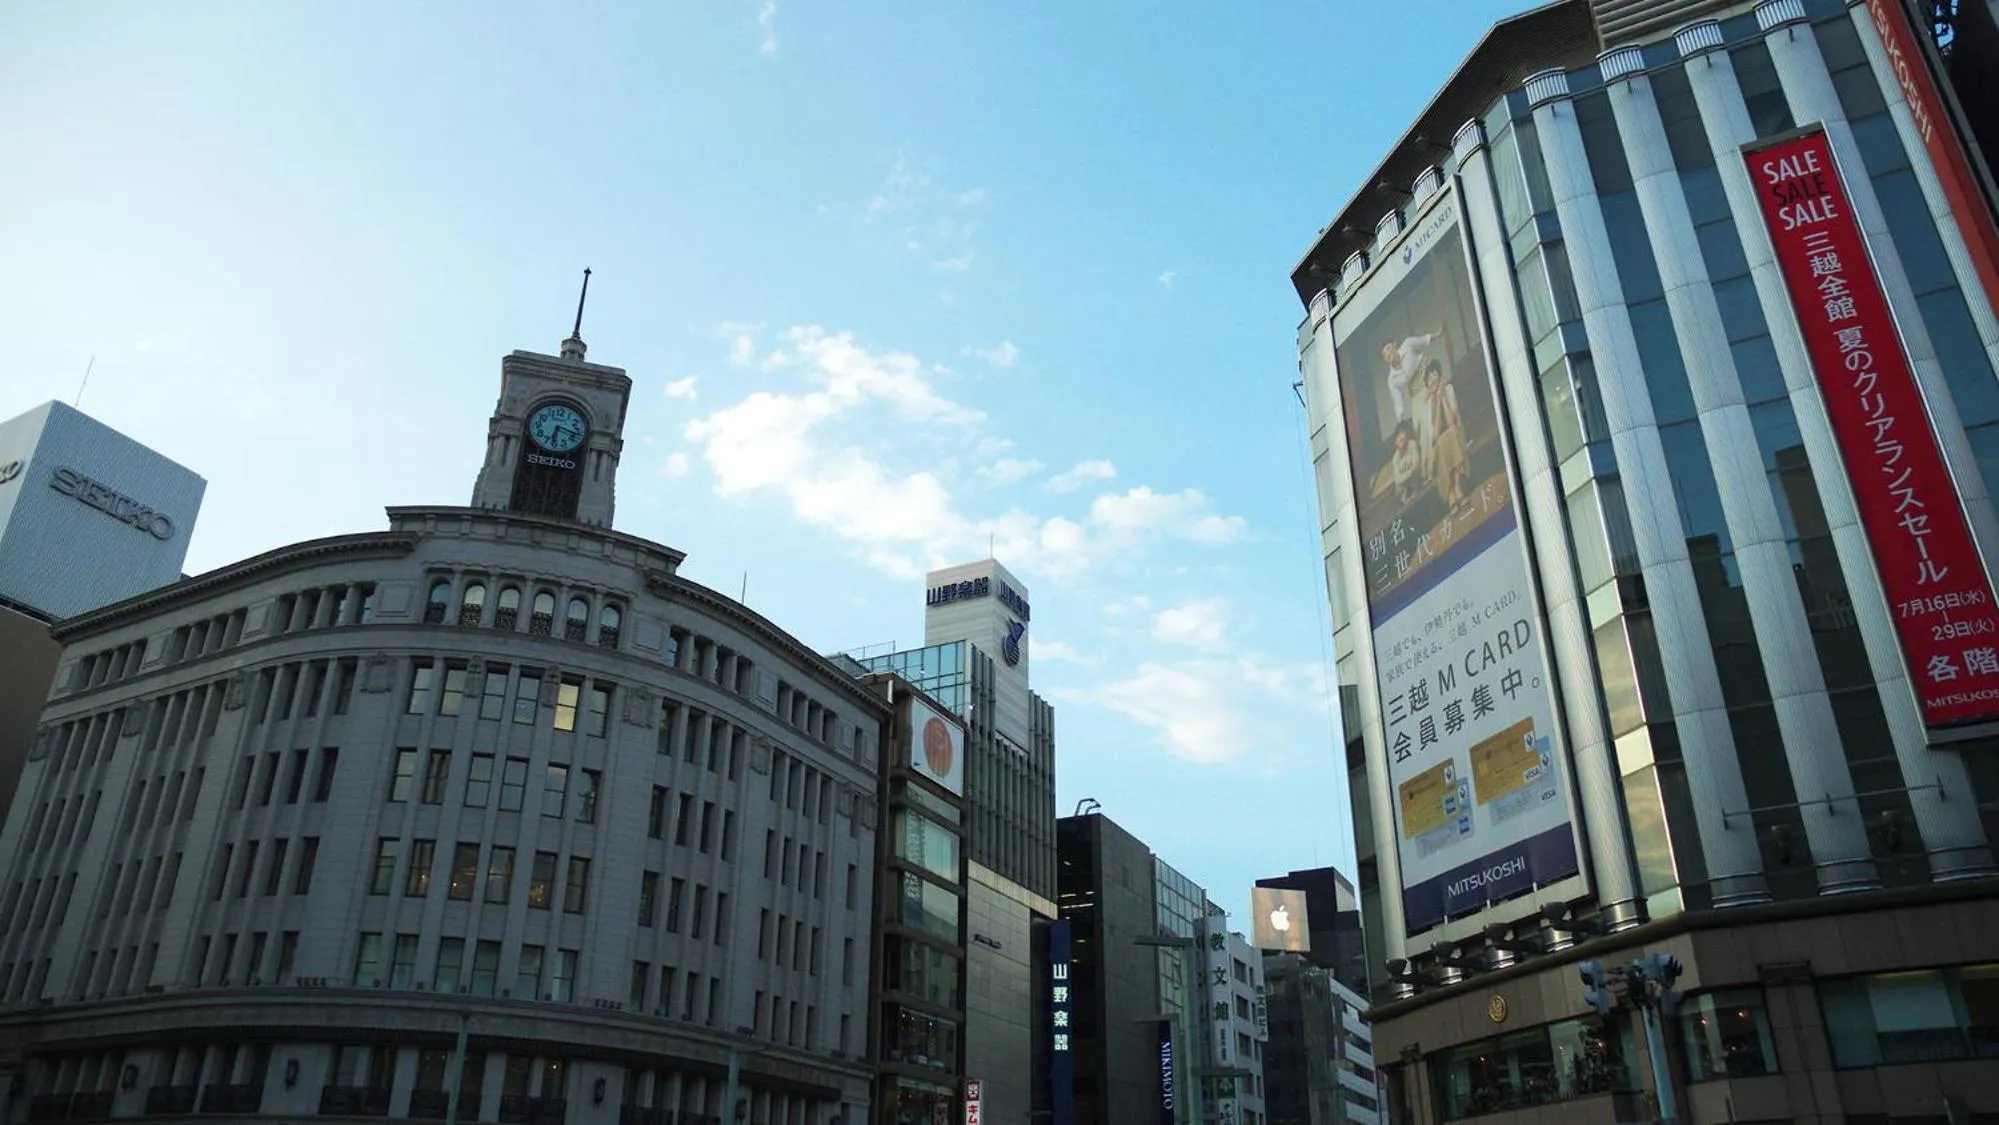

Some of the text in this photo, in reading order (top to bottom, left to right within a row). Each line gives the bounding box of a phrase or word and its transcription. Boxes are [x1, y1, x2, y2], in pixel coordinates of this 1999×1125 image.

[1763, 150, 1821, 185] SALE
[1771, 173, 1830, 208] SALE
[1778, 195, 1839, 231] SALE
[1802, 231, 1949, 586] 三越全館 夏のクリアランスセール
[0, 459, 24, 484] O
[527, 453, 576, 469] SEIKO
[49, 466, 175, 541] SEIKO
[1369, 519, 1415, 562] 別名、
[1388, 619, 1532, 727] 三越 M CARD
[1393, 667, 1541, 764] 会員募集中。
[1447, 855, 1525, 898] MITSUKOSHI
[1160, 1041, 1174, 1111] MIKIMOTO
